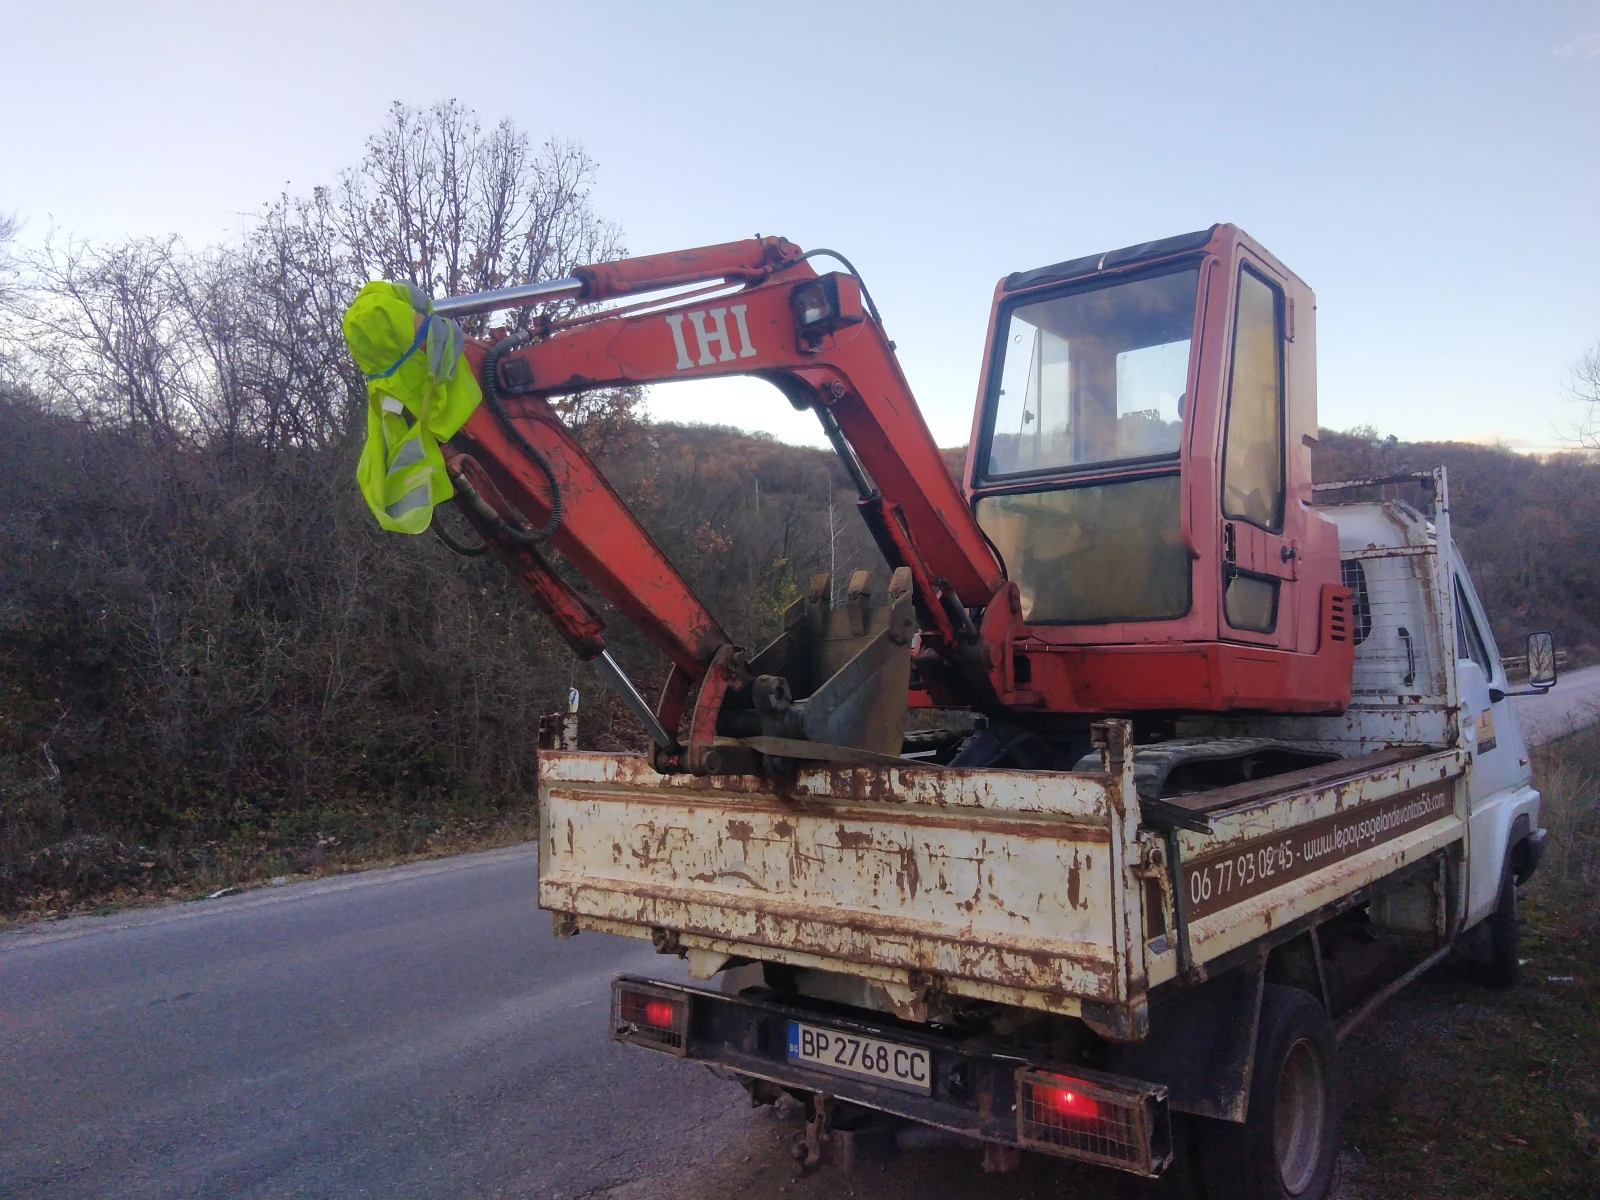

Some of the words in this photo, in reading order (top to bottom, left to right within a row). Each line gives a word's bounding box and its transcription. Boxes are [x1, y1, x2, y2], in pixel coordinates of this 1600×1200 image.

[665, 304, 757, 370] IHI
[1191, 868, 1211, 904] 06
[1215, 860, 1233, 895] 77
[1237, 853, 1256, 887] 93
[1258, 846, 1275, 879] 02
[1278, 839, 1293, 870] 45
[789, 1043, 799, 1053] BG
[802, 1029, 829, 1059] BP
[834, 1036, 889, 1073] 2768
[894, 1049, 926, 1082] CC
